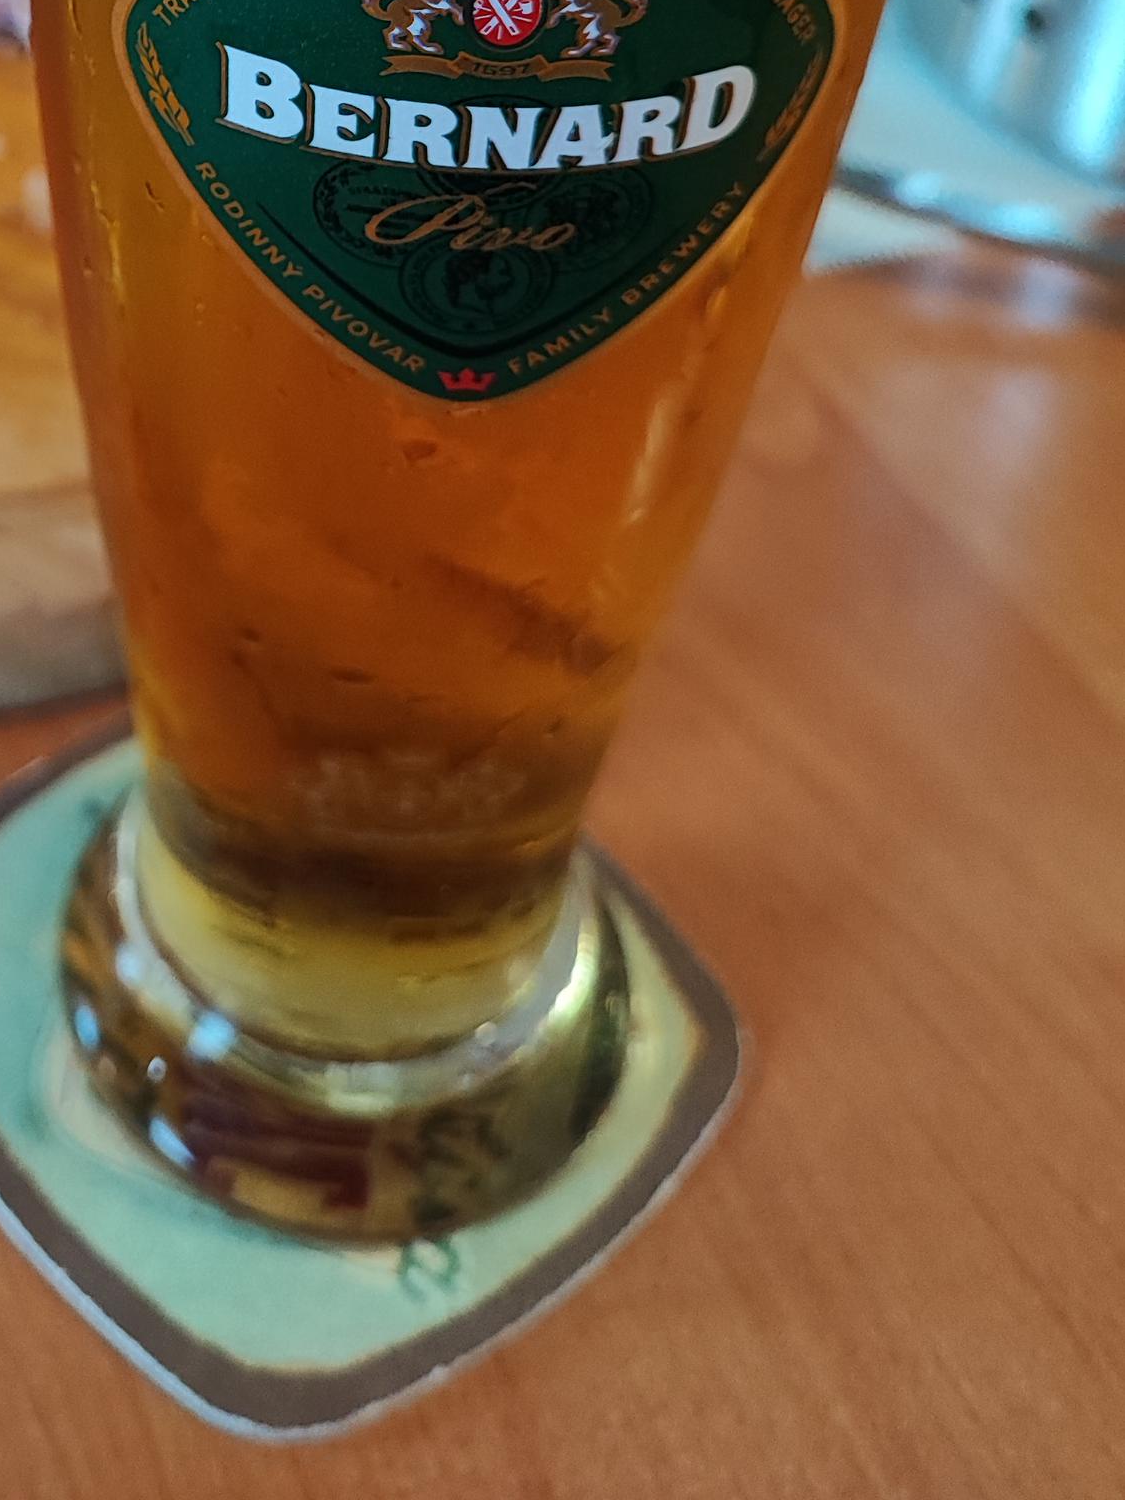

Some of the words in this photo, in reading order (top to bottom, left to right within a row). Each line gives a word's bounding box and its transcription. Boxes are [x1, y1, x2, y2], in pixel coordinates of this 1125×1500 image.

[215, 40, 757, 174] BERNARD
[302, 283, 425, 372] PIVOVAR
[507, 306, 612, 374] FAMILY
[620, 181, 744, 305] BREWERY
